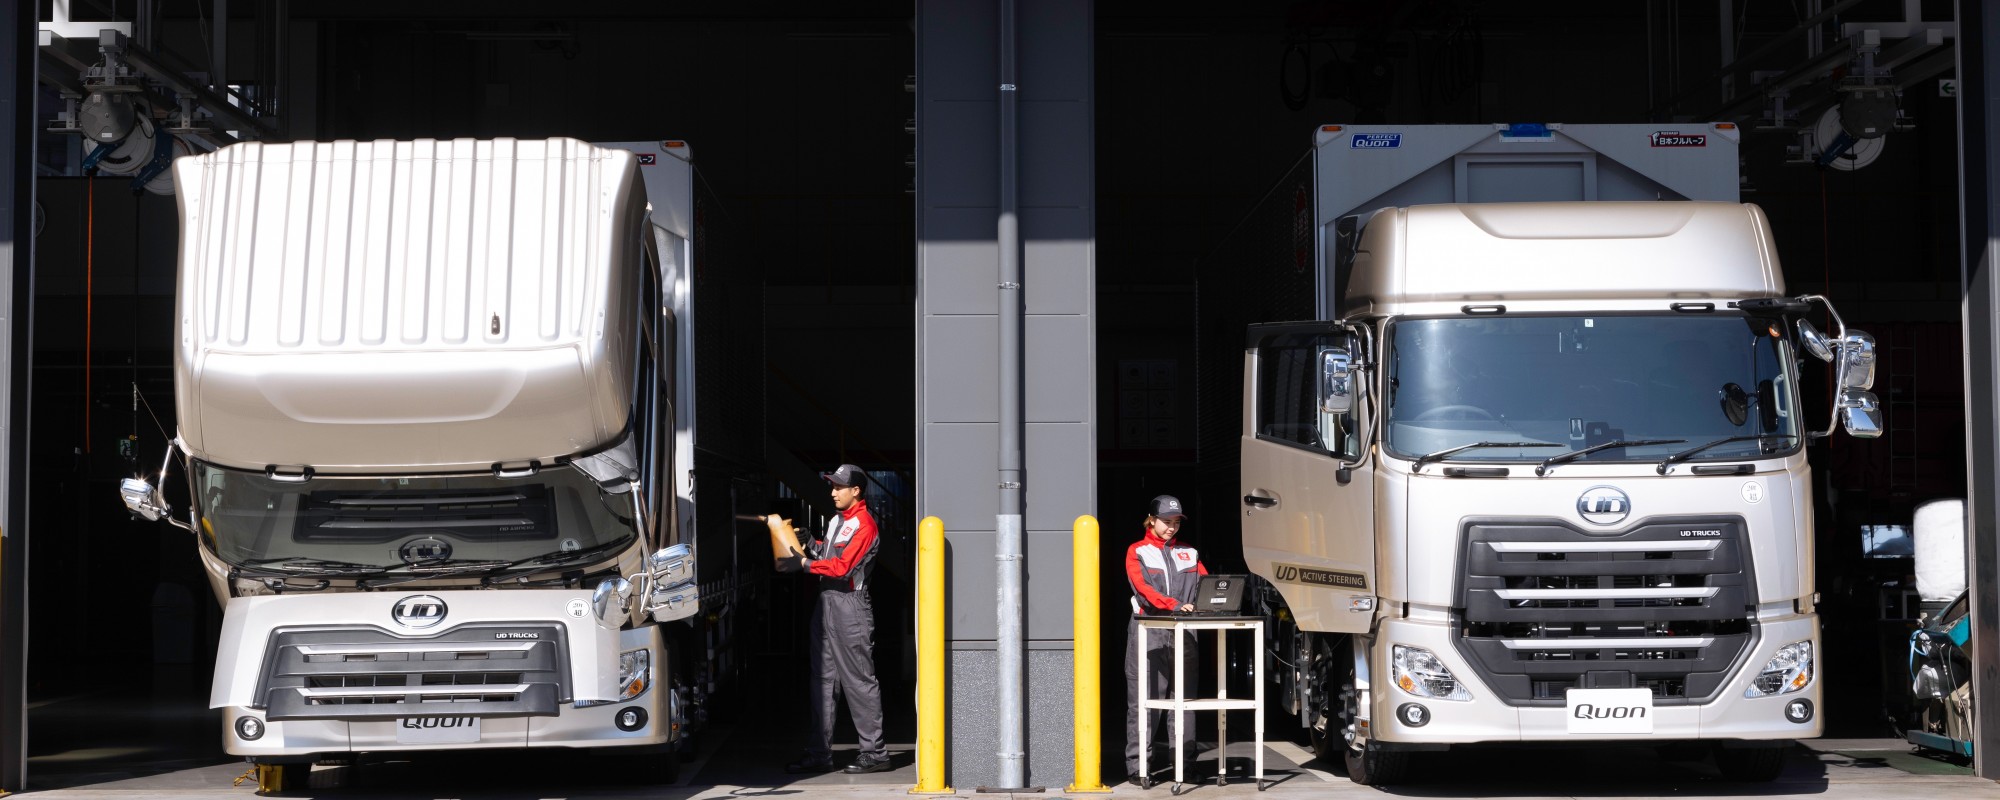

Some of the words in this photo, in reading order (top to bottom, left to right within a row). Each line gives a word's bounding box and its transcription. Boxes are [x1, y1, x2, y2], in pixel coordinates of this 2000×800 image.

[1356, 139, 1390, 148] Quon
[1659, 137, 1704, 145] 日本フルハーフ
[1581, 496, 1628, 514] UD
[1276, 565, 1298, 581] UD
[1302, 571, 1327, 582] ACTIVE
[1328, 574, 1364, 586] STEERING
[396, 603, 444, 619] UD
[1574, 703, 1646, 720] Quon
